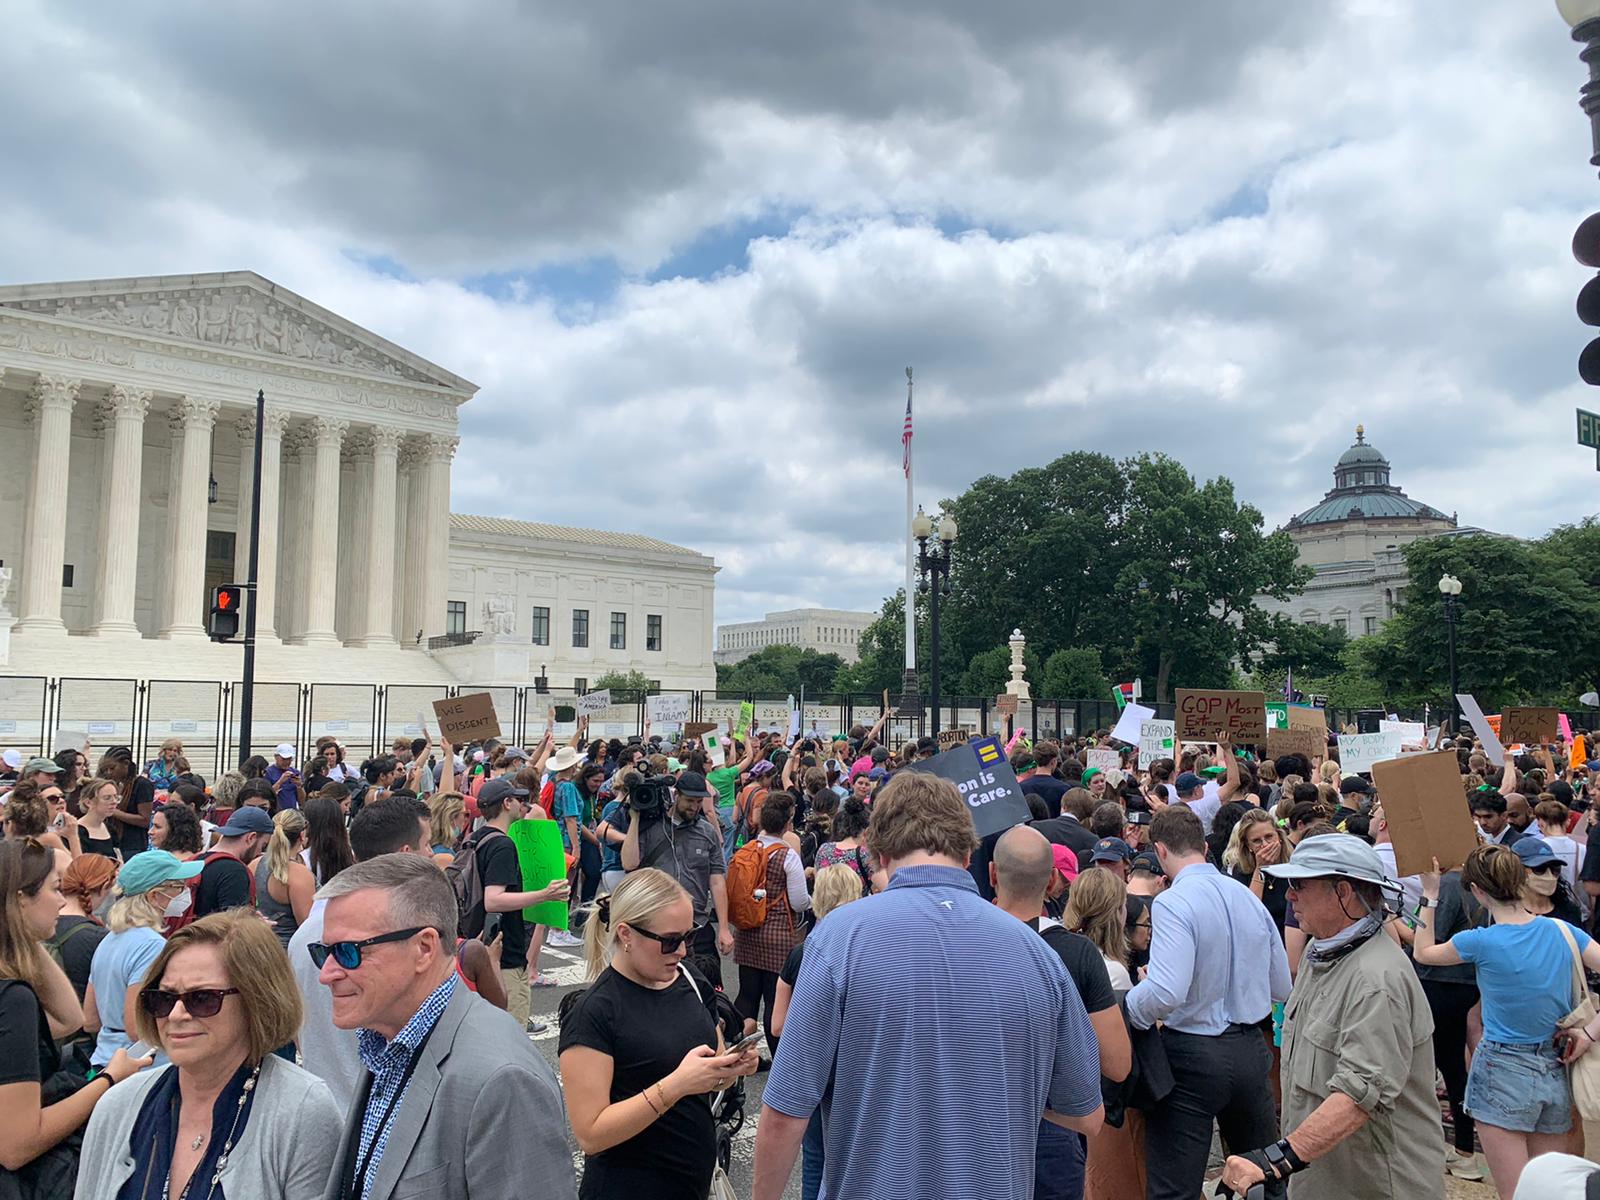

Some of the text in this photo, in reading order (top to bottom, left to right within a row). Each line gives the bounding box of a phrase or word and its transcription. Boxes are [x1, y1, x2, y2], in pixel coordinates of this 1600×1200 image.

[441, 705, 464, 716] WE
[1181, 695, 1222, 714] GOP
[446, 717, 489, 732] DISSENT
[1140, 723, 1173, 737] EXPAND
[937, 729, 970, 743] ABORTION
[1339, 734, 1386, 746] MY BODY
[1145, 739, 1162, 751] THE
[1346, 748, 1361, 758] MY
[979, 771, 996, 786] is
[968, 787, 1012, 807] Care.
